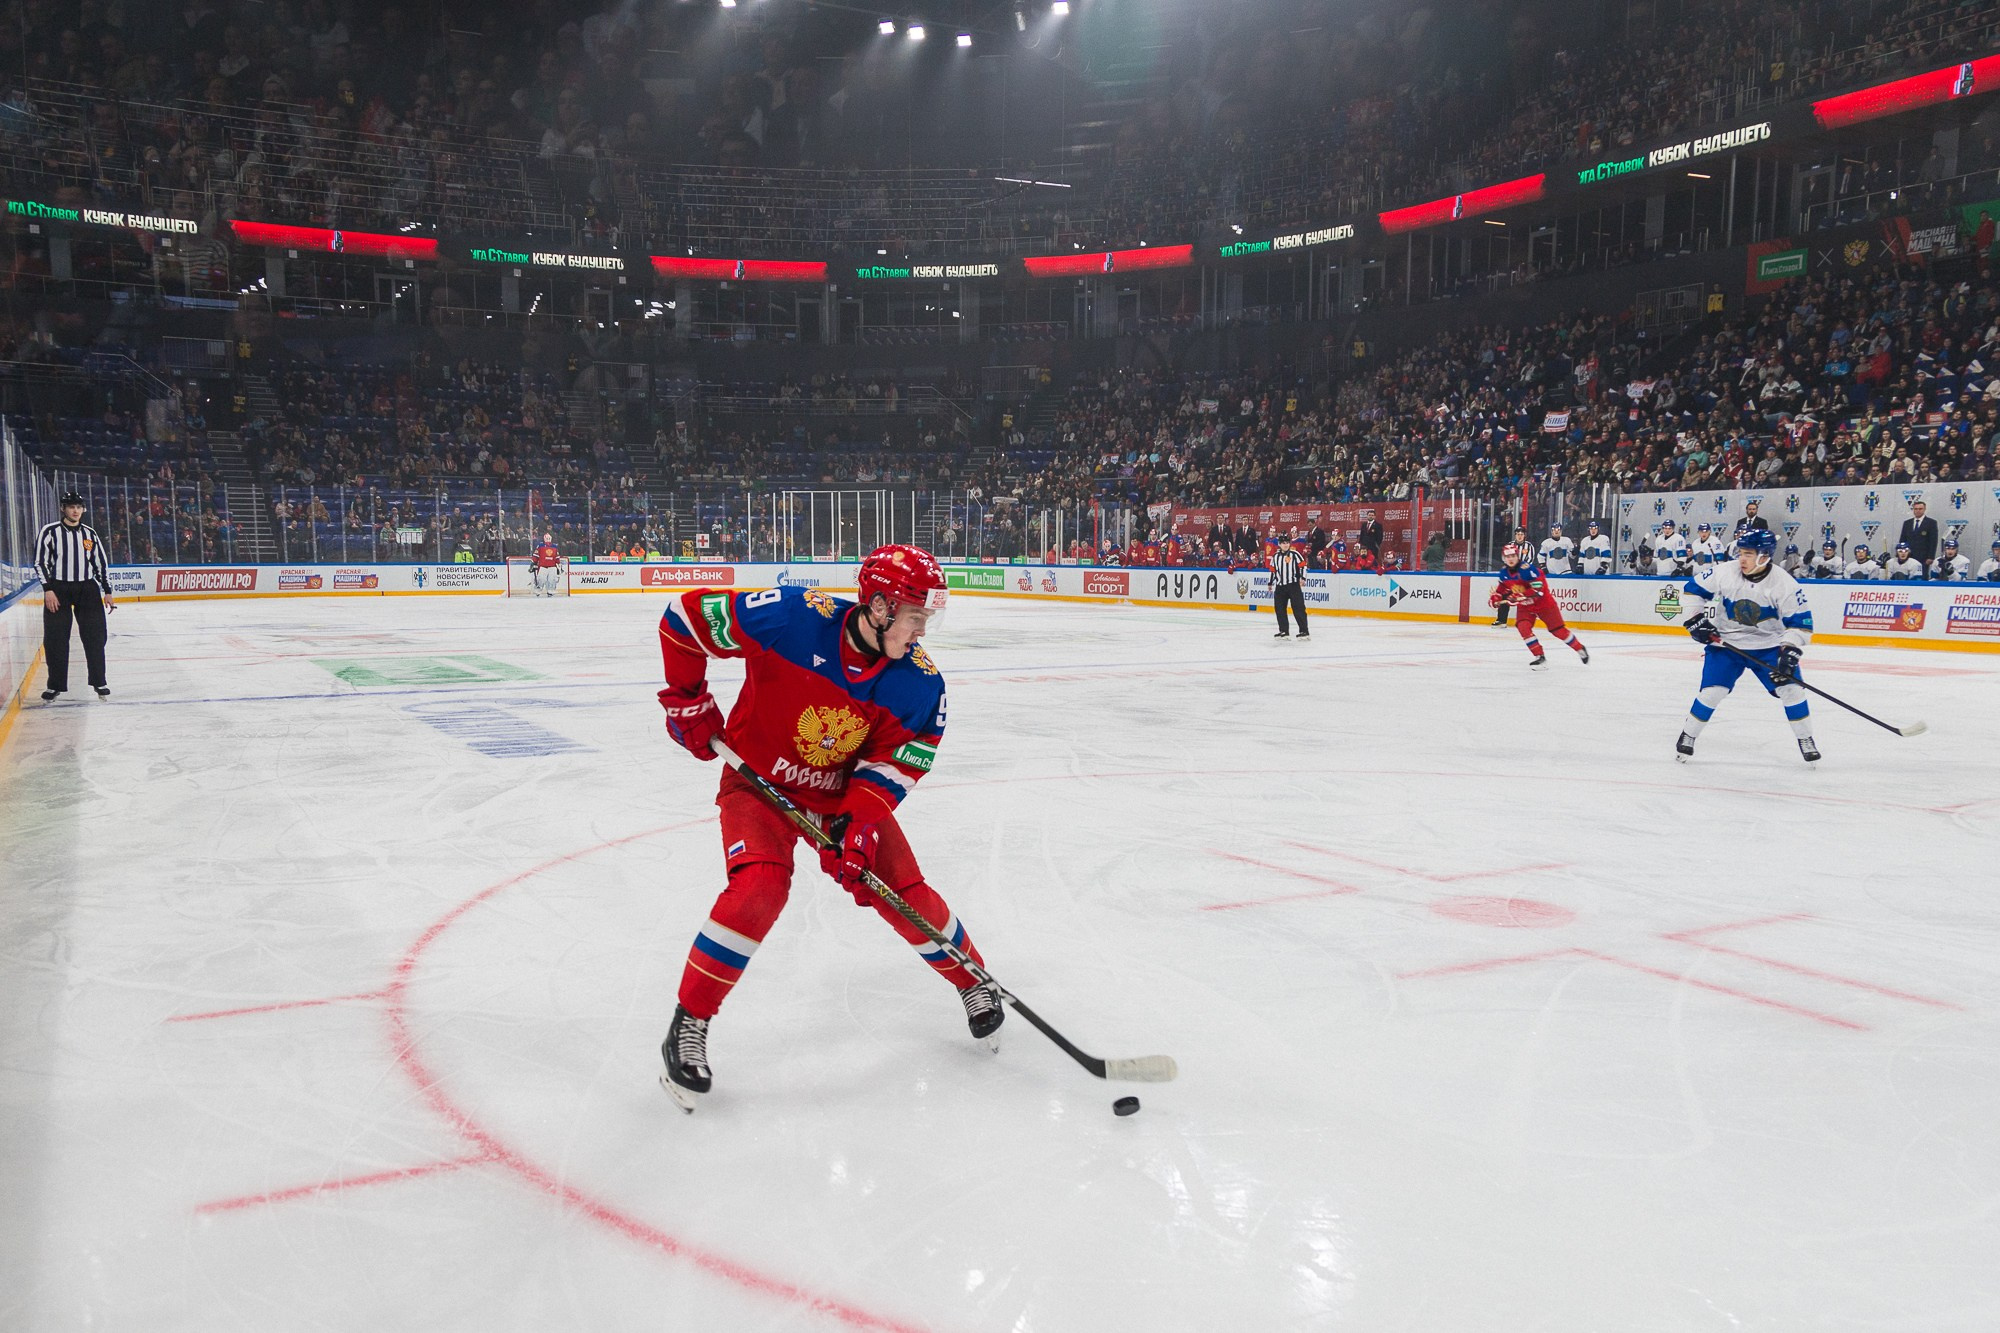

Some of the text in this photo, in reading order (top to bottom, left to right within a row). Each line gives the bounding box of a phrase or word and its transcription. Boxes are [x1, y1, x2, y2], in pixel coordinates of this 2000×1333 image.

[1649, 141, 1691, 167] КУБОК
[1693, 121, 1771, 157] БУДУЩЕГО
[84, 209, 124, 227] КУБОК
[128, 214, 198, 234] БУДУЩЕГО
[1273, 233, 1304, 250] КУБОК
[1306, 224, 1354, 246] БУДУЩЕГО
[1909, 226, 1947, 241] КРАСНАЯ
[532, 252, 566, 267] КУБОК
[568, 255, 624, 270] БУДУЩЕГО
[913, 266, 943, 277] КУБОК
[946, 264, 998, 278] БУДУЩЕГО
[122, 571, 142, 581] СПОРТА
[161, 569, 252, 591] ИГРАЙВРОССИИ.РФ
[652, 569, 723, 583] Альфа Банк
[788, 578, 820, 587] ГАЗПРОМ
[114, 583, 146, 592] ФЕДЕРАЦИИ
[1088, 583, 1125, 594] СПОРТ
[1157, 573, 1218, 600] АУРА
[1350, 587, 1442, 599] СИБИРЬ АРЕНА
[1850, 591, 1896, 603] КРАСНАЯ
[1560, 602, 1602, 612] РОССИИ
[1846, 603, 1895, 617] МАШИНА
[902, 750, 922, 766] ЛИГА
